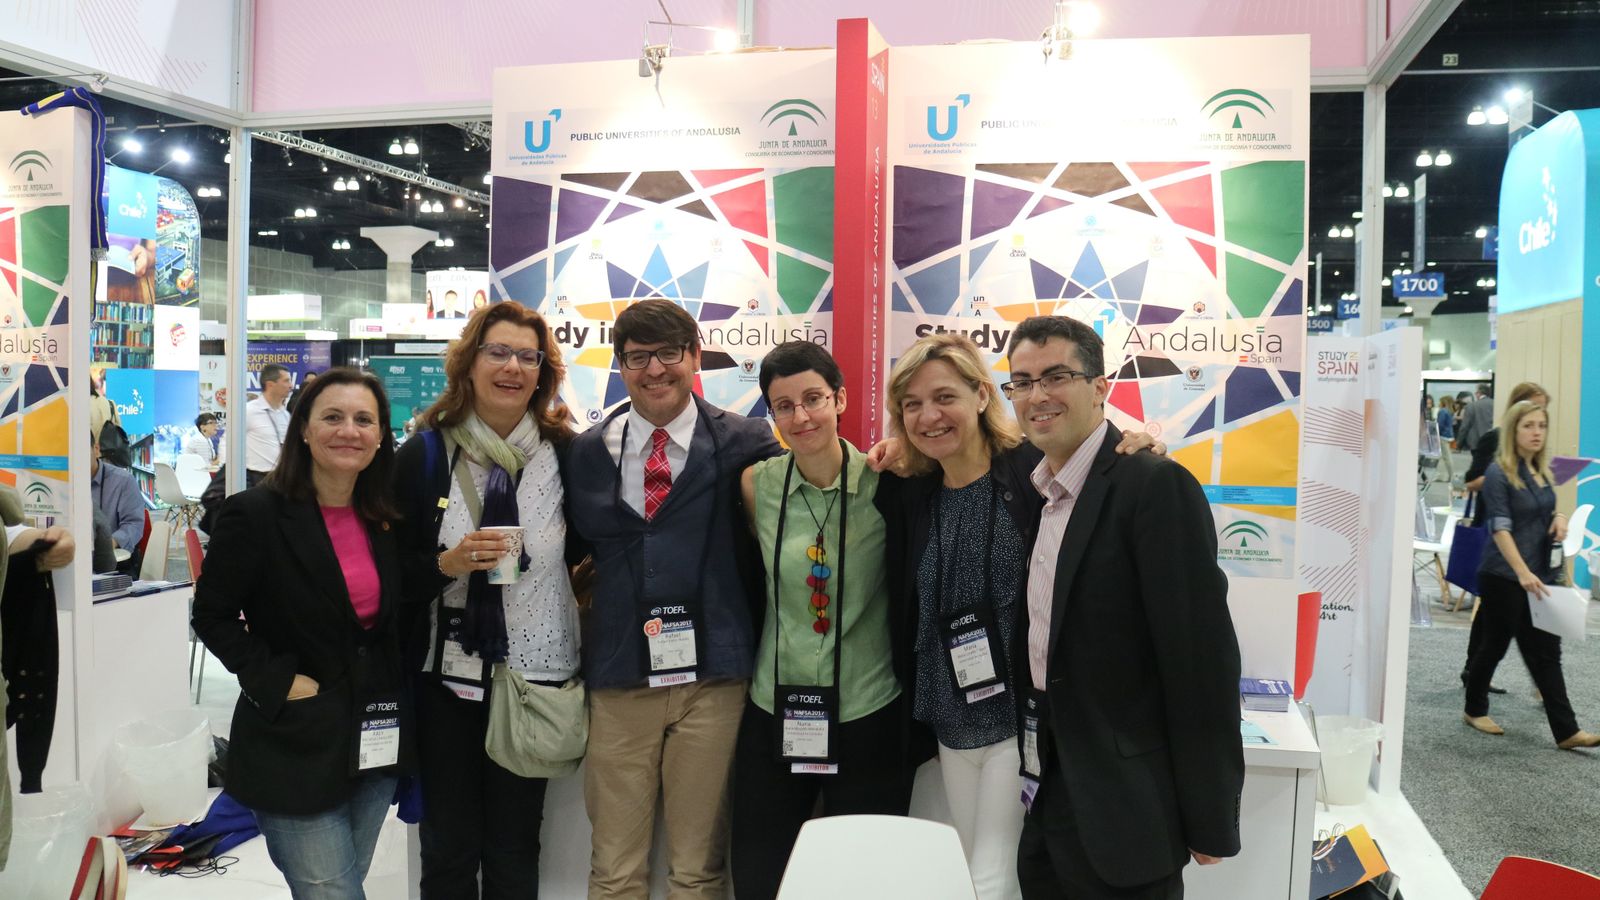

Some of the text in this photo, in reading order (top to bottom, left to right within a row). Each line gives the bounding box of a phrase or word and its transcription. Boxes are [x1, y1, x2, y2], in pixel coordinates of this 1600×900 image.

[1445, 56, 1457, 65] 23
[981, 119, 1018, 129] PUBLIC
[570, 126, 741, 142] PUBLIC UNIVERSITIES OF ANDALUSIA
[1200, 133, 1222, 142] JUNTA
[1225, 133, 1233, 142] DE
[759, 141, 779, 149] JUNTA
[782, 140, 789, 149] DE
[873, 146, 881, 257] ANDALUSIA
[1519, 216, 1551, 255] Chile
[1400, 278, 1438, 292] 1700
[1344, 304, 1360, 315] 16
[1307, 320, 1330, 329] 1500
[0, 332, 58, 354] alusia
[915, 323, 1283, 354] Sdy Andalusia
[38, 353, 58, 363] Spain
[247, 354, 298, 364] EXPERIENCE
[870, 293, 878, 421] UNIVERSITIES
[1250, 353, 1282, 365] Spain
[1318, 351, 1348, 361] STUDY
[1317, 361, 1359, 375] SPAIN
[116, 404, 139, 416] Chile
[663, 605, 688, 615] TOEFL
[1321, 602, 1354, 612] ation.
[959, 613, 979, 627] TOEFL
[799, 694, 824, 704] TOEFL
[377, 702, 400, 711] TOEFL
